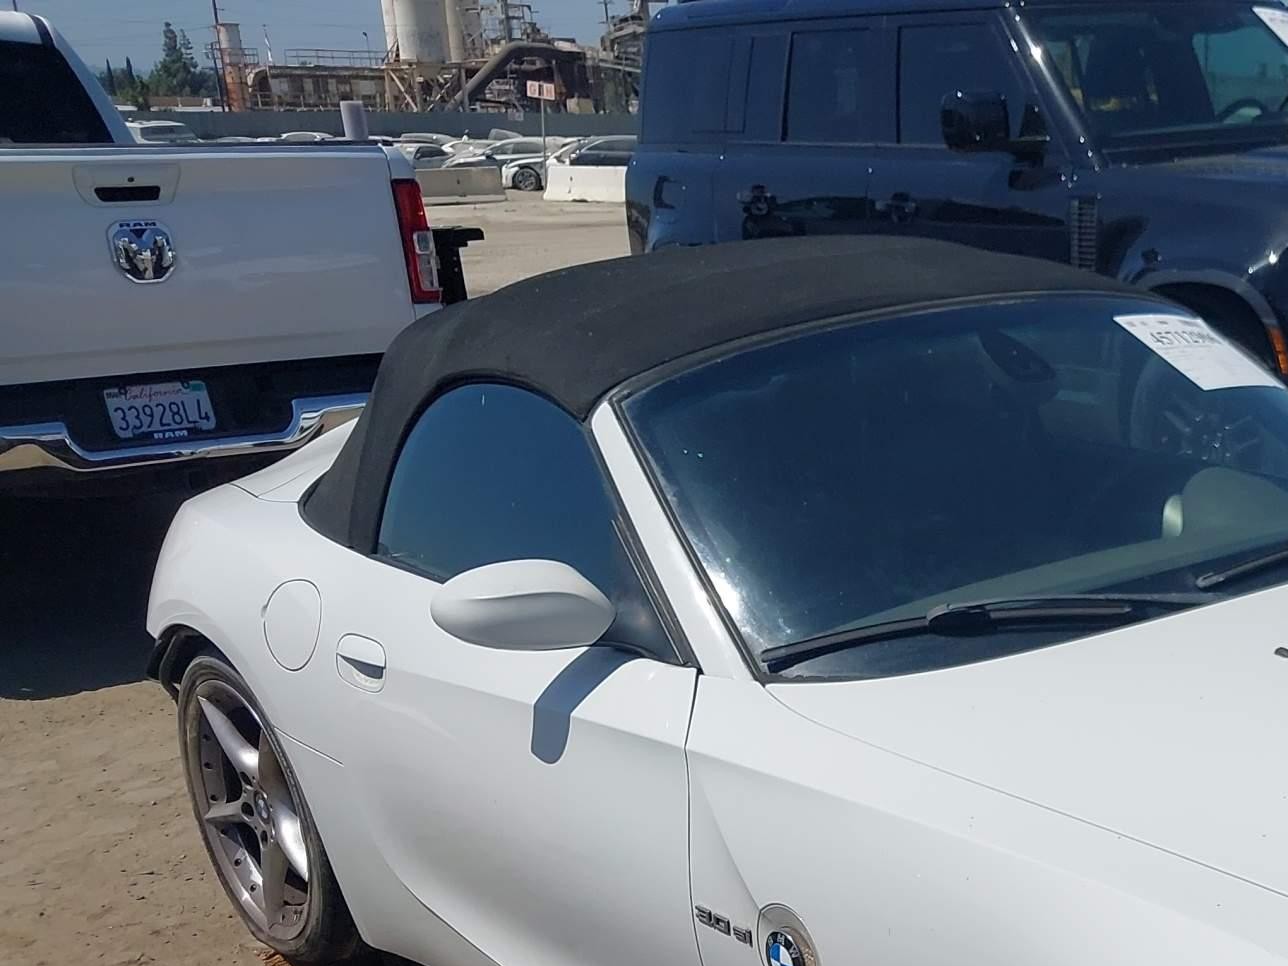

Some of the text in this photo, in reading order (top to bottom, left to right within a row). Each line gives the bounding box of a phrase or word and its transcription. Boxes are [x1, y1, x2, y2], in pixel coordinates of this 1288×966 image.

[113, 399, 211, 432] 33928L4
[153, 430, 188, 439] RAM
[767, 932, 800, 959] BMW
